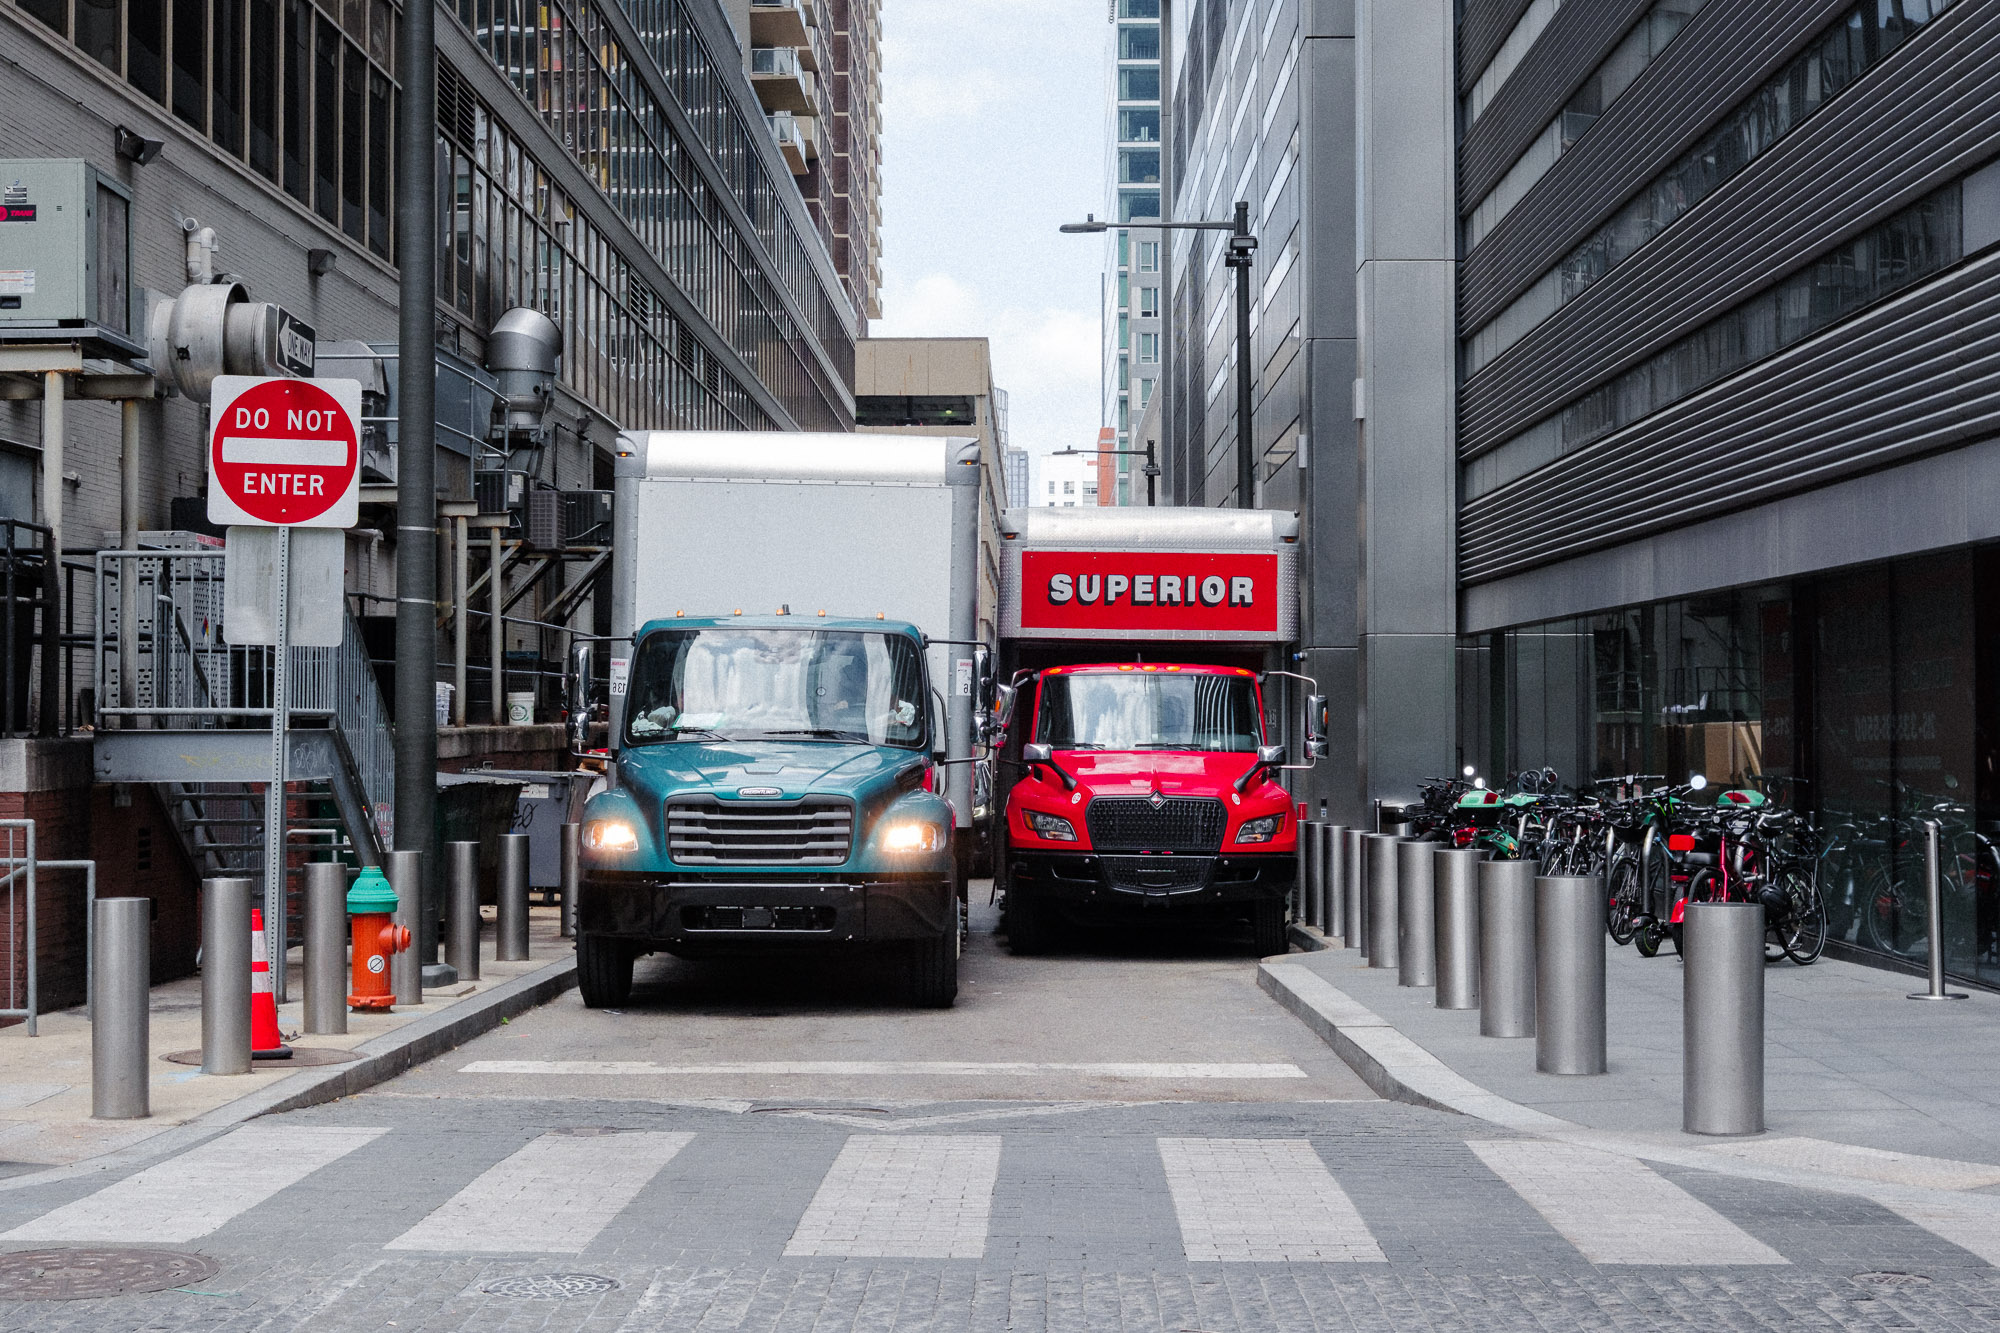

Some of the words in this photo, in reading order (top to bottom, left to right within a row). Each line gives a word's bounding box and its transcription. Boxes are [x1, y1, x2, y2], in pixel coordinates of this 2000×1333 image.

[288, 331, 299, 357] ONE
[300, 338, 312, 365] WAY
[235, 408, 270, 430] DO
[287, 409, 337, 431] NOT
[243, 472, 324, 496] ENTER
[1047, 573, 1254, 607] SUPERIOR
